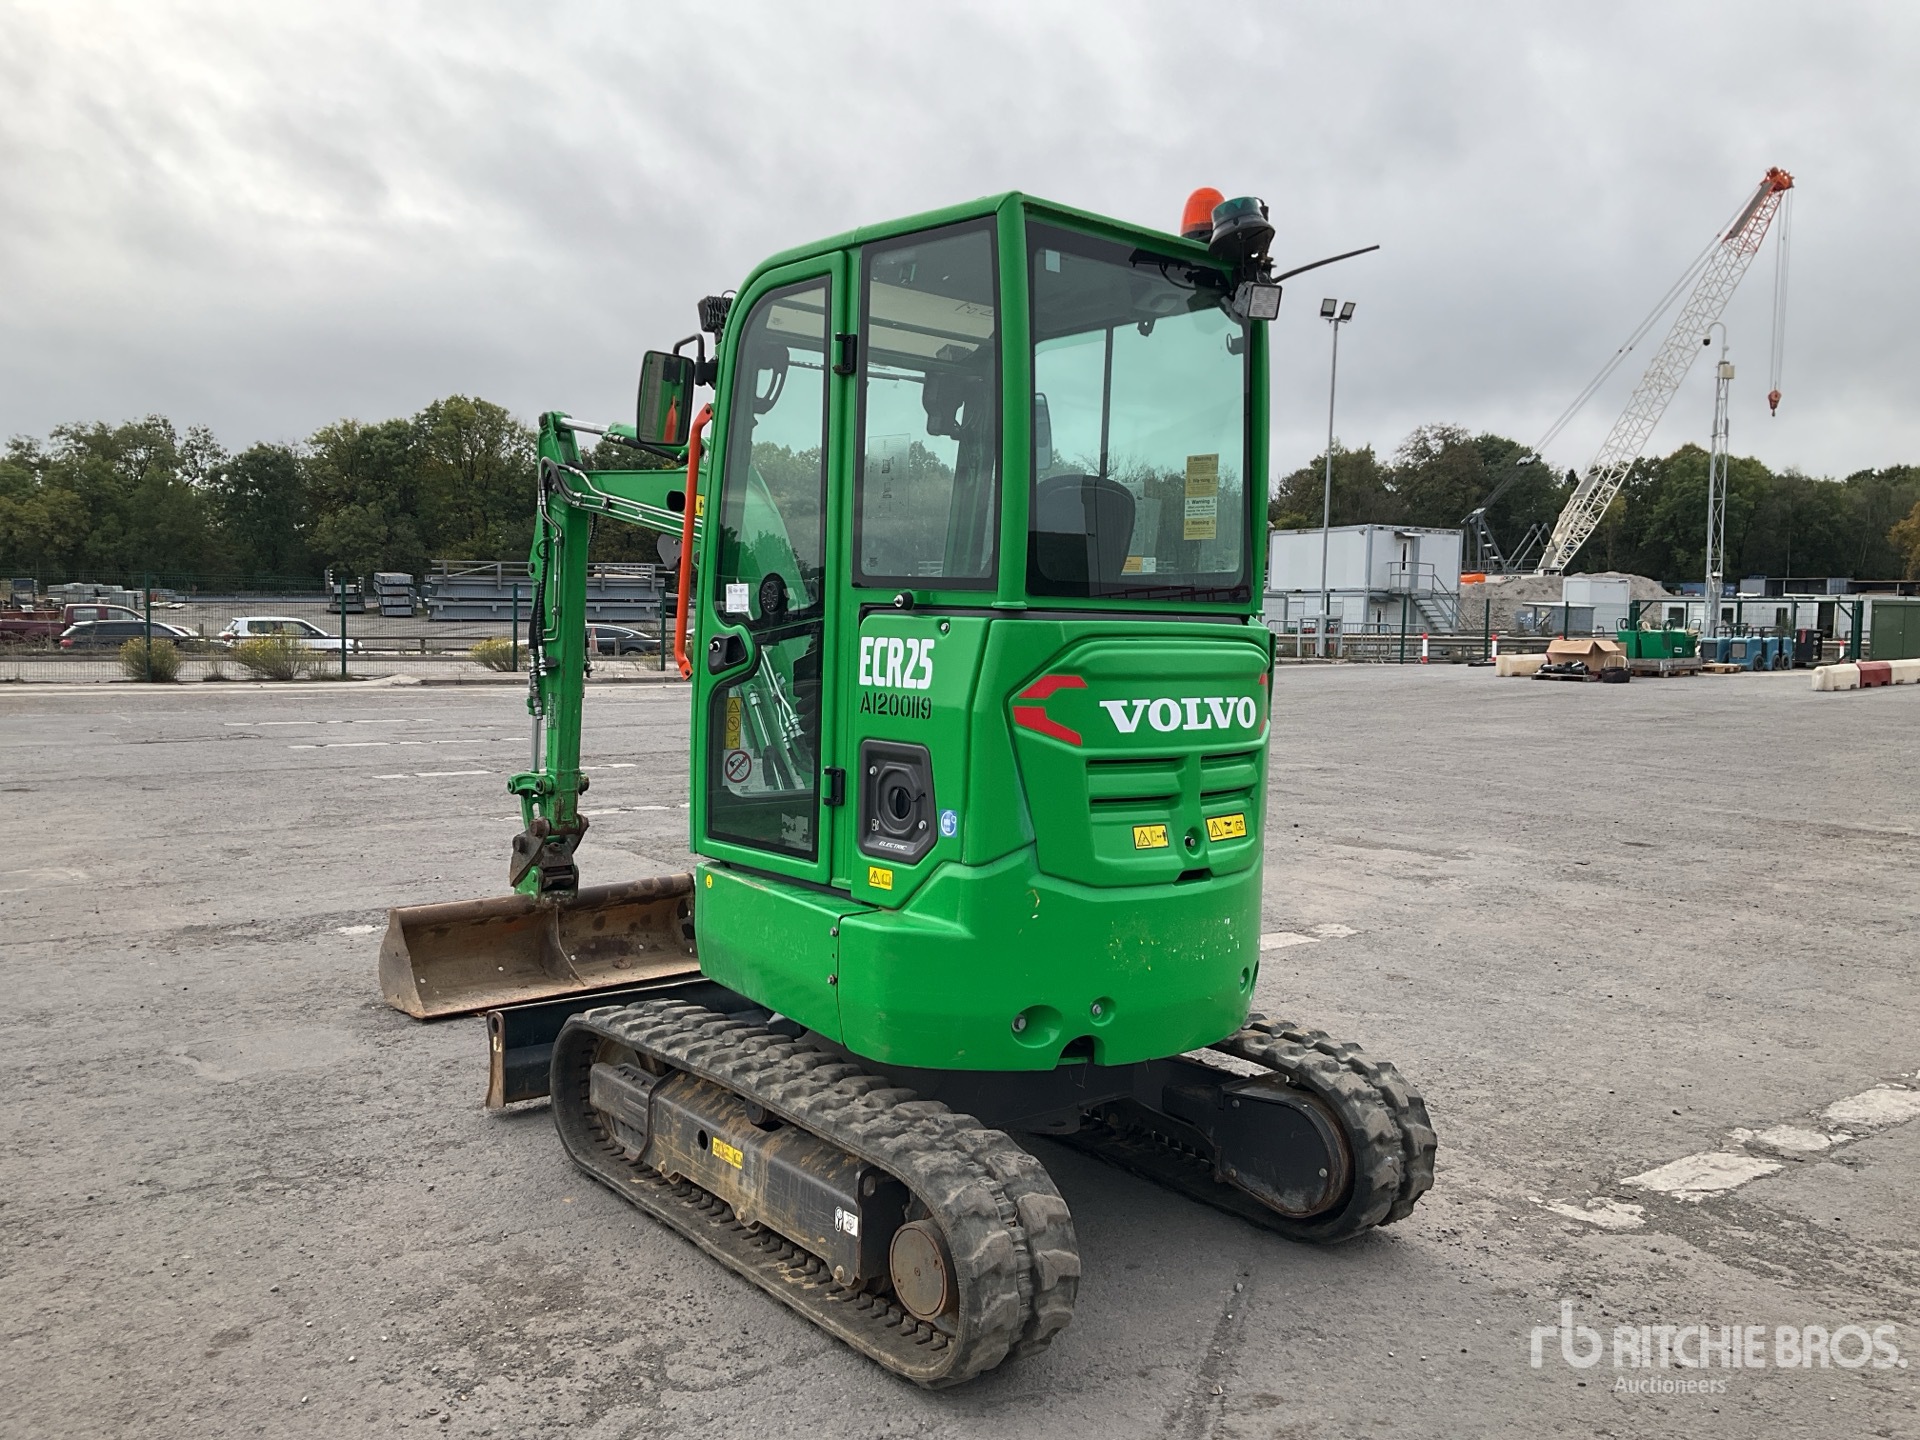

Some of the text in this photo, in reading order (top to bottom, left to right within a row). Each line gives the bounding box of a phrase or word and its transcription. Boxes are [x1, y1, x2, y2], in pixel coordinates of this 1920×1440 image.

[859, 636, 935, 690] ECR25
[1099, 696, 1257, 734] VOLVO
[878, 840, 908, 851] ELECTRIC
